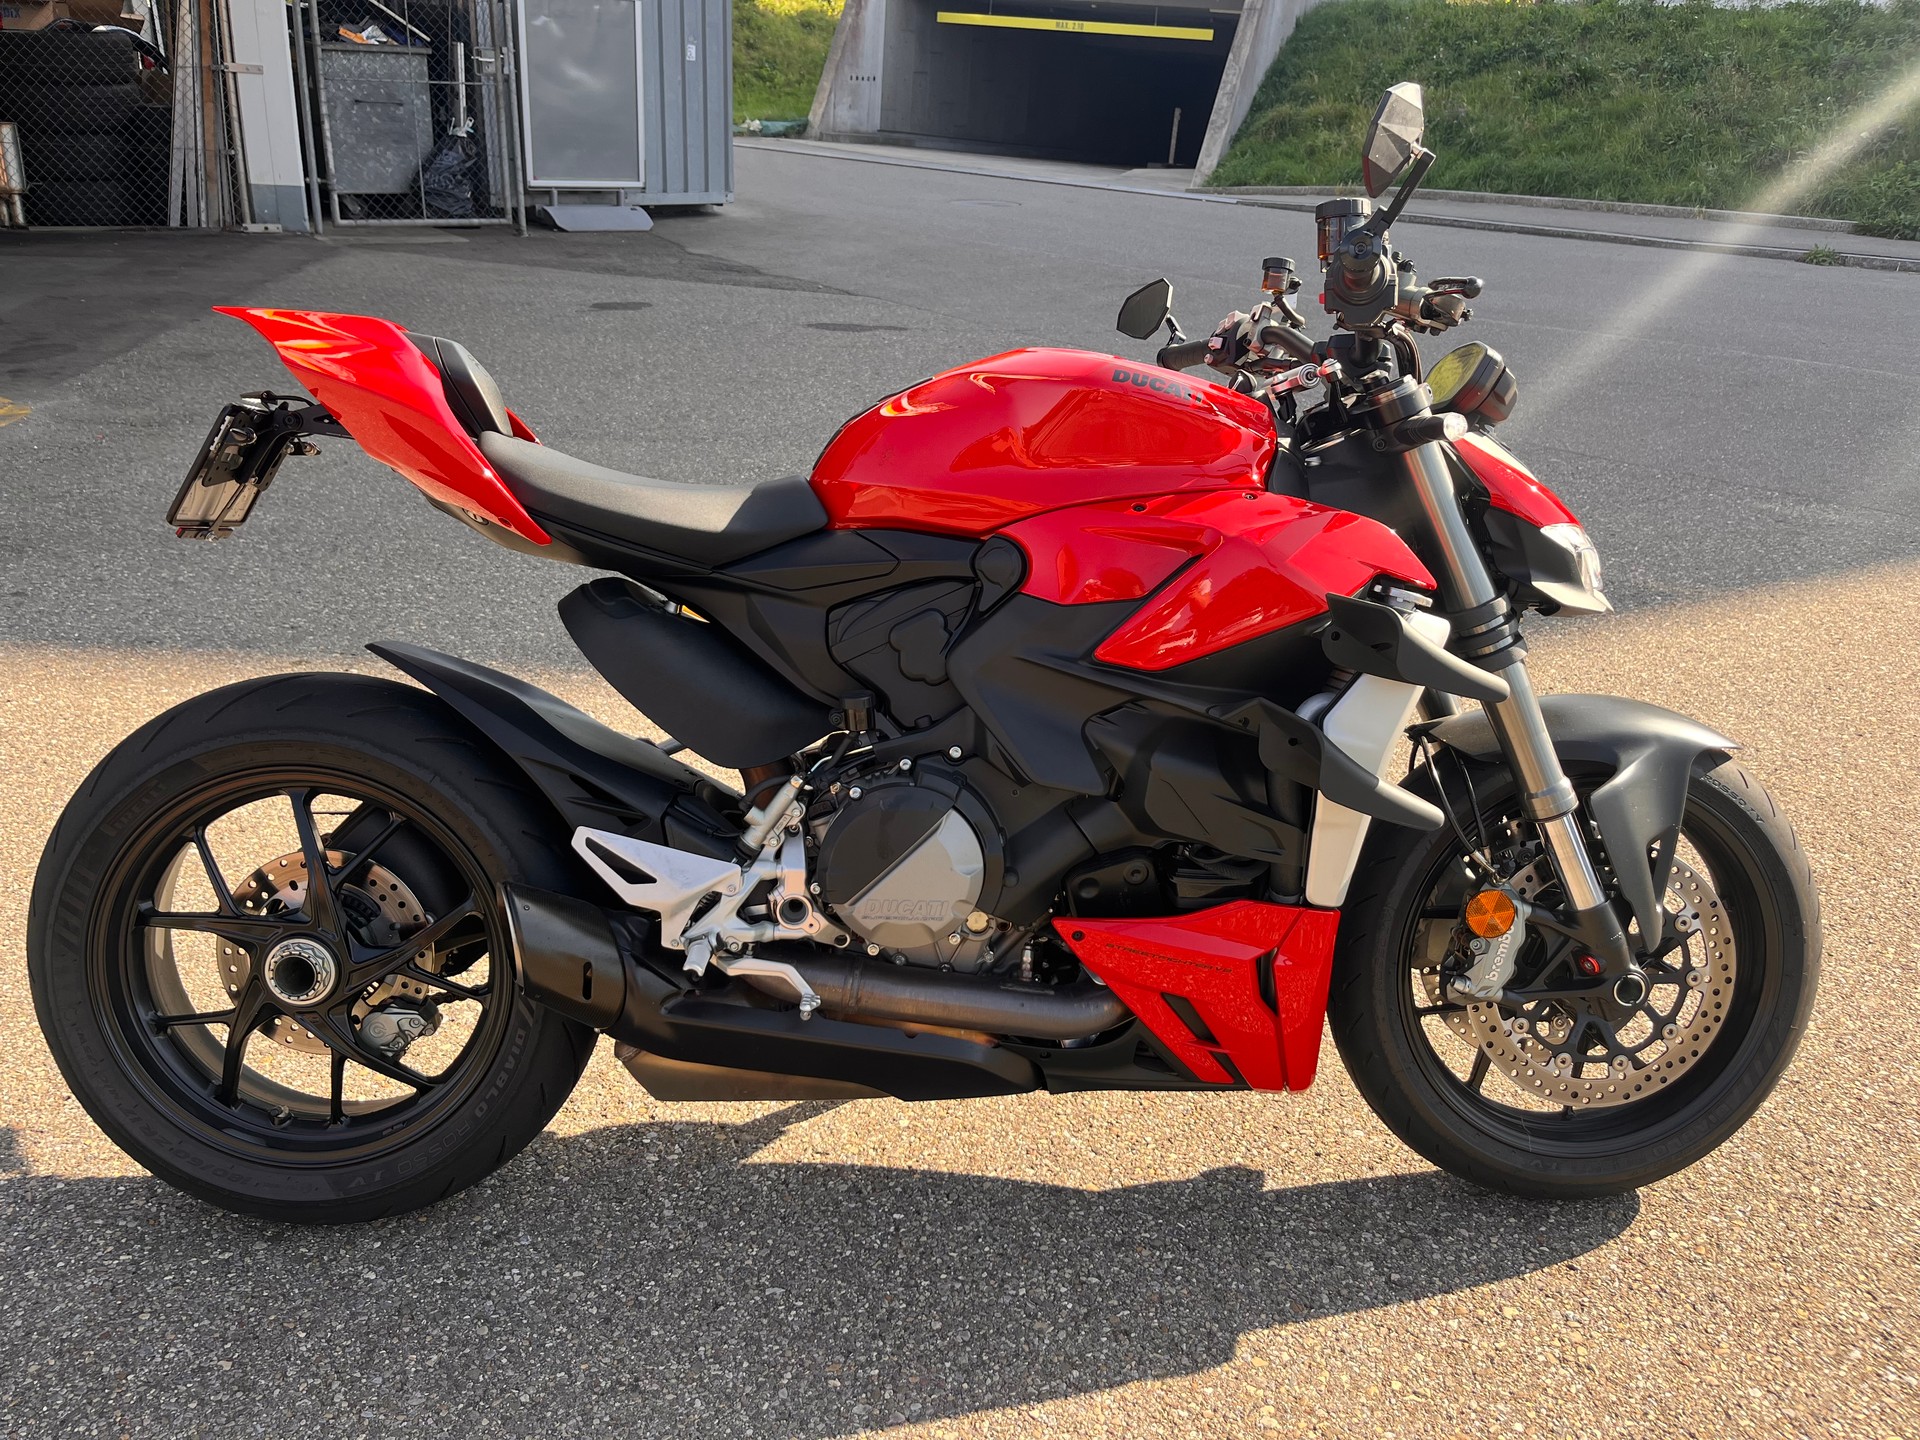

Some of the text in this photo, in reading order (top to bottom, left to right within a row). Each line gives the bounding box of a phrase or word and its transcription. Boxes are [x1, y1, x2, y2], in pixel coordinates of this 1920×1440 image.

[1111, 369, 1204, 405] DUCATI
[1701, 774, 1747, 809] ROSSO
[863, 899, 949, 916] DUCATI
[474, 1027, 526, 1118] DIABLO
[397, 1120, 472, 1175] ROSSO
